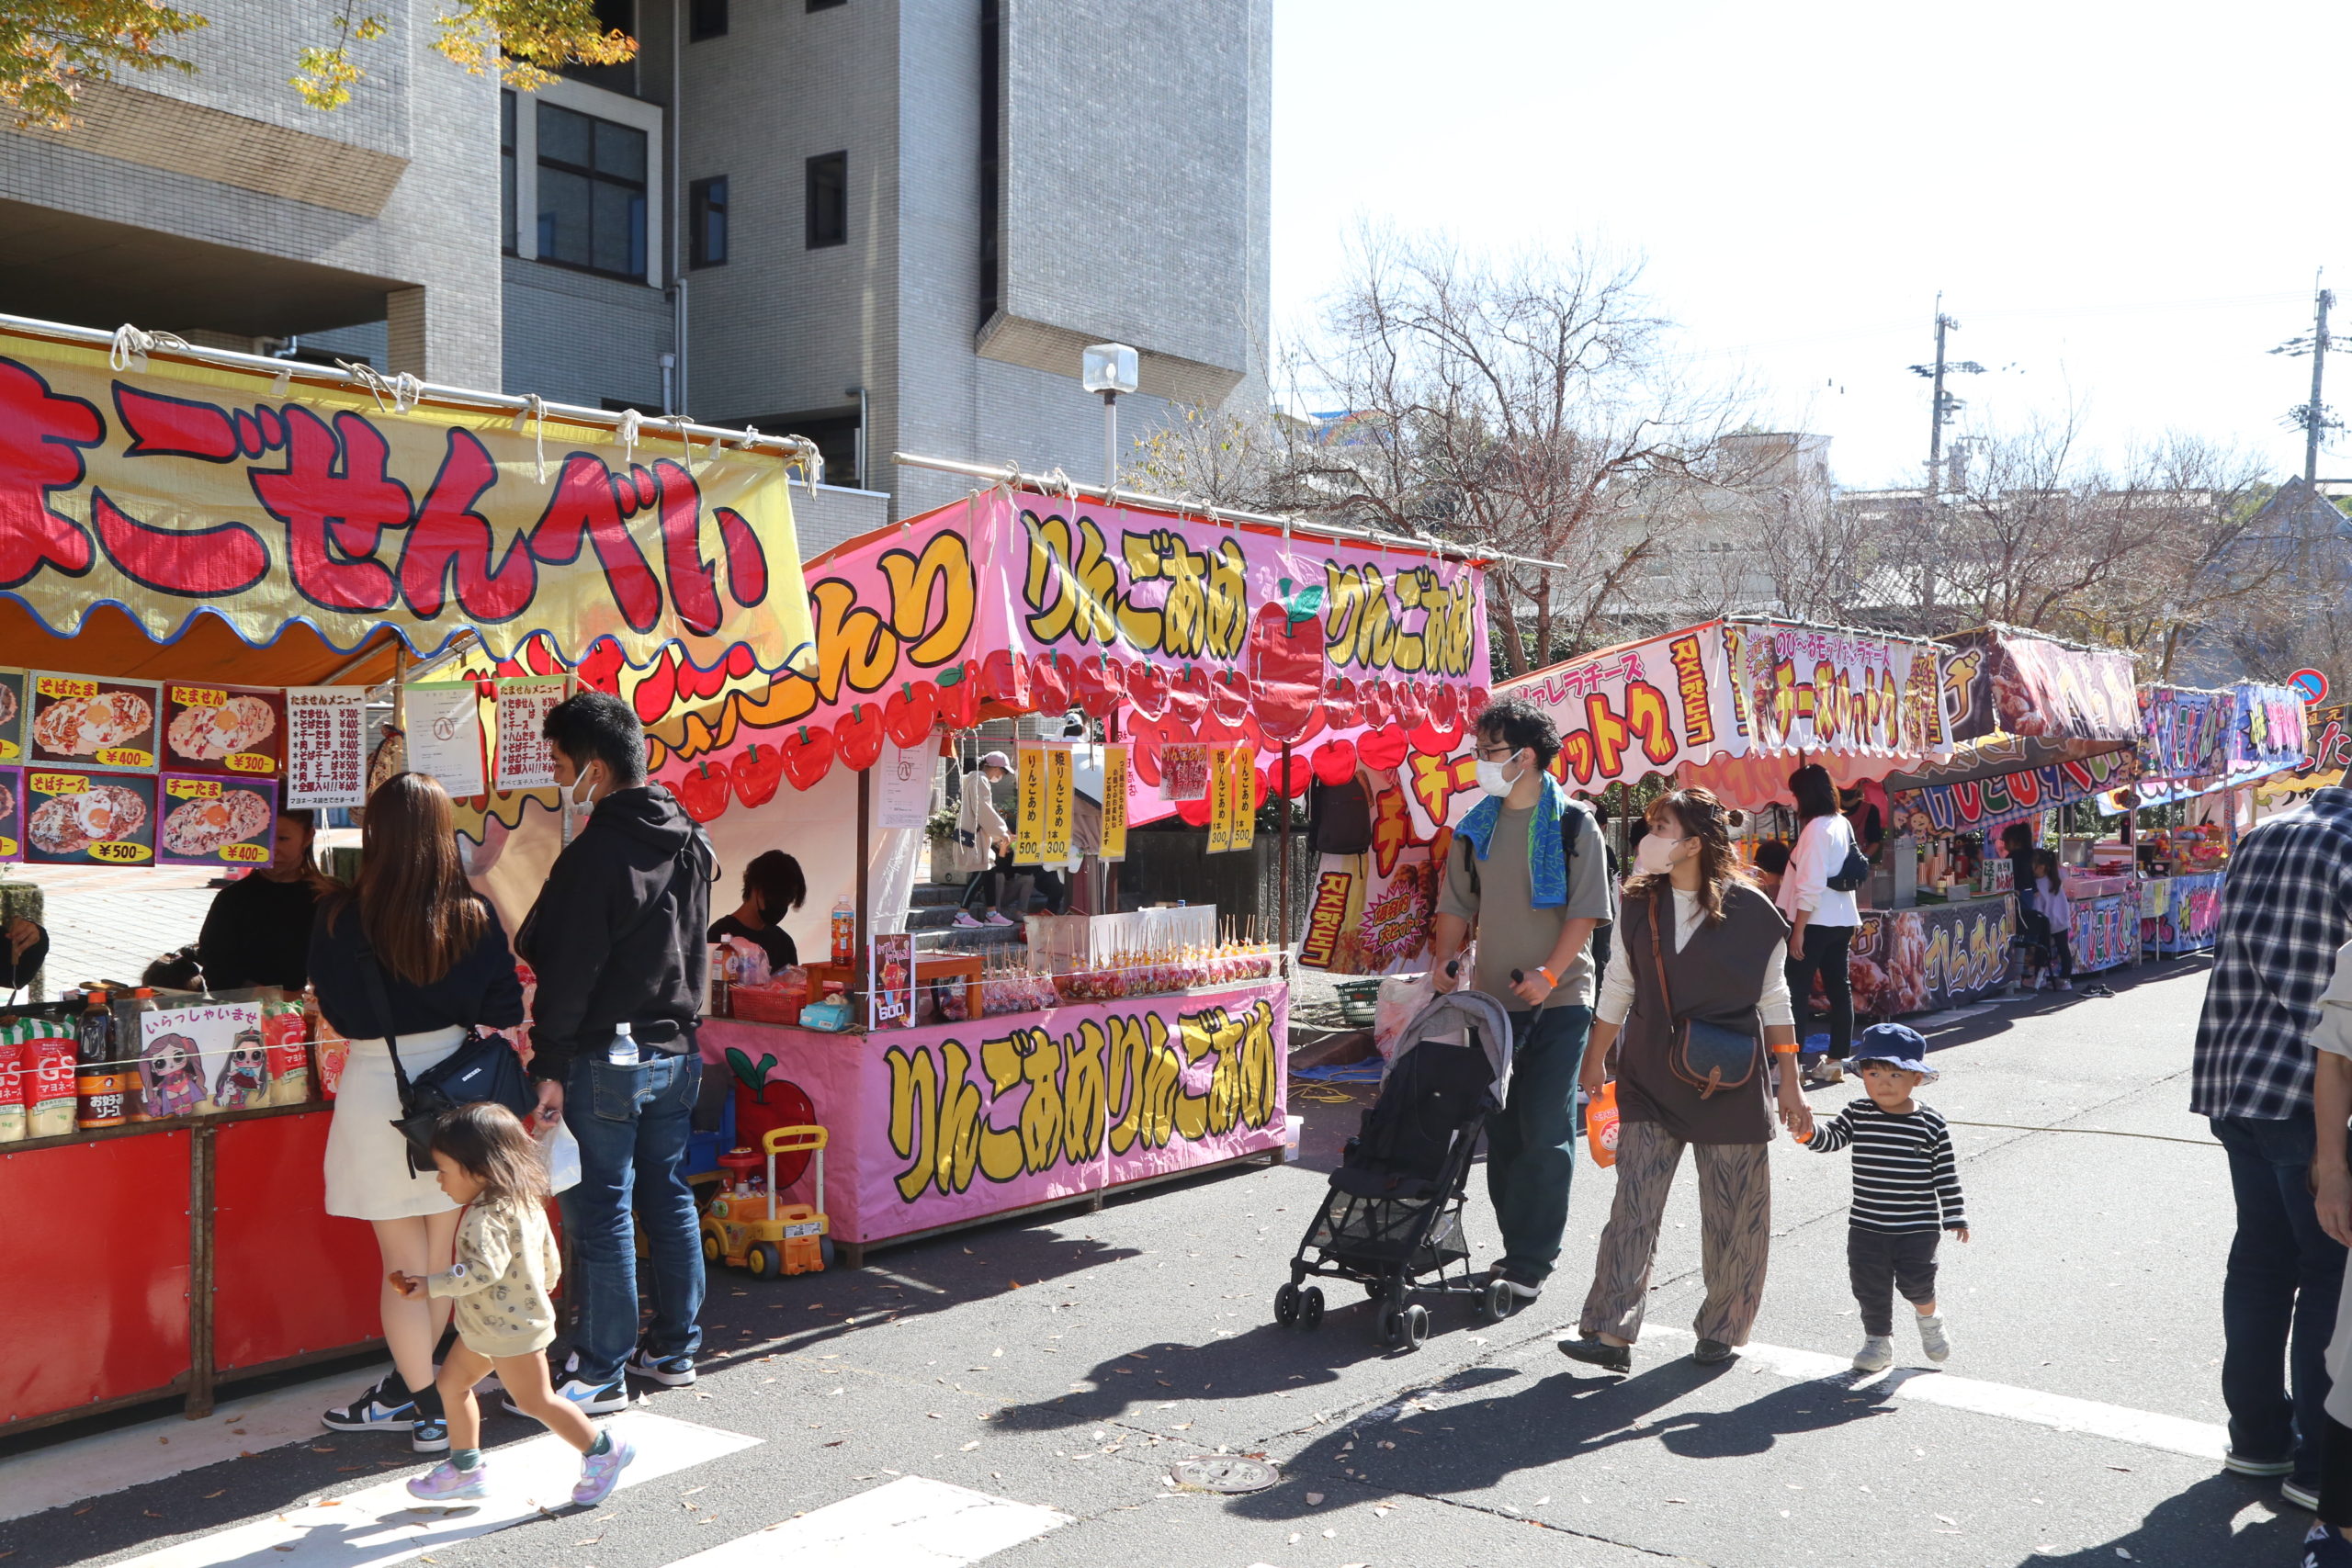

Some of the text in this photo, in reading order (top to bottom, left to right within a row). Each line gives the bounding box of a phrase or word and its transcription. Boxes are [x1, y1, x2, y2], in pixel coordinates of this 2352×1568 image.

[1020, 509, 1249, 660] りんごあめ
[1325, 558, 1476, 677] りんごあめ
[40, 678, 96, 697] そばたま
[500, 684, 561, 695] たませんメニュー
[174, 688, 224, 705] たません
[290, 694, 362, 706] たませんメニュー
[508, 698, 536, 708] たません
[299, 709, 331, 718] たません
[299, 719, 331, 729] そばたま
[299, 730, 331, 739] チーたま
[33, 775, 87, 793] そばチーズ
[169, 781, 220, 796] チーたま
[1213, 822, 1222, 830] 1本
[1236, 819, 1245, 828] 1本
[1020, 830, 1031, 840] 1本
[1047, 829, 1058, 839] 1本
[878, 1002, 904, 1021] 600
[145, 1007, 258, 1035] いらっしゃいませ
[38, 1055, 77, 1081] GS
[1103, 998, 1276, 1156] りんごあめ
[96, 1106, 121, 1119] ソース
[885, 1020, 1105, 1204] りんごあめ
